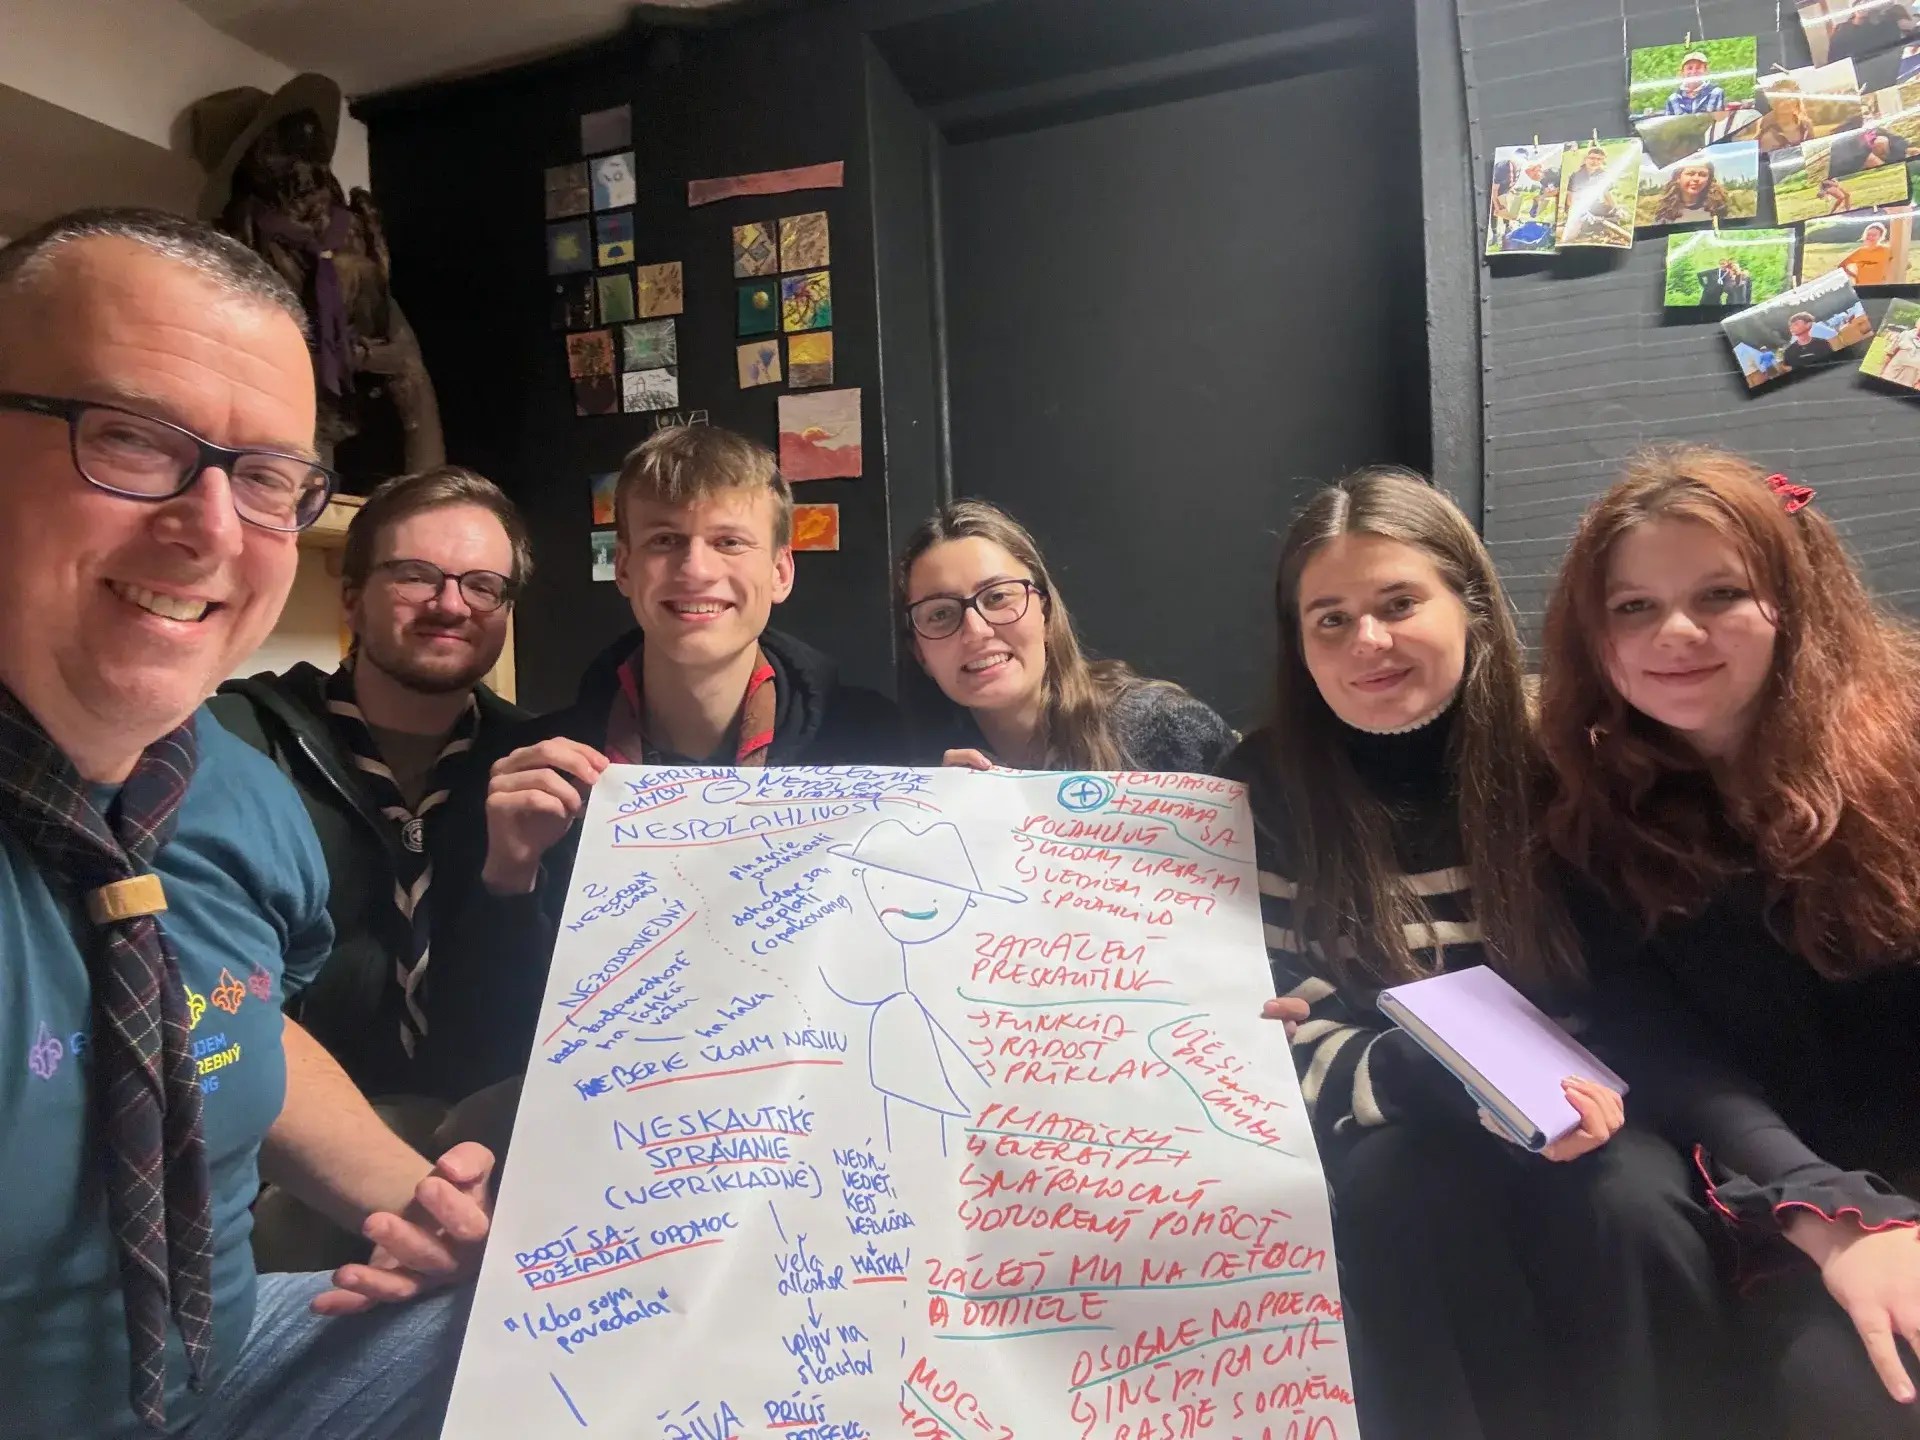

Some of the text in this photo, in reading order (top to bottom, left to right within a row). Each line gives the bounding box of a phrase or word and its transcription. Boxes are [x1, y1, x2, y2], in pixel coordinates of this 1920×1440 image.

[612, 1095, 816, 1150] NESKAUTSKÉ
[645, 1134, 792, 1169] SPRÁVANIE
[1068, 1254, 1124, 1288] MU
[1141, 1258, 1189, 1287] NA
[587, 1286, 634, 1317] som
[836, 1324, 870, 1343] na
